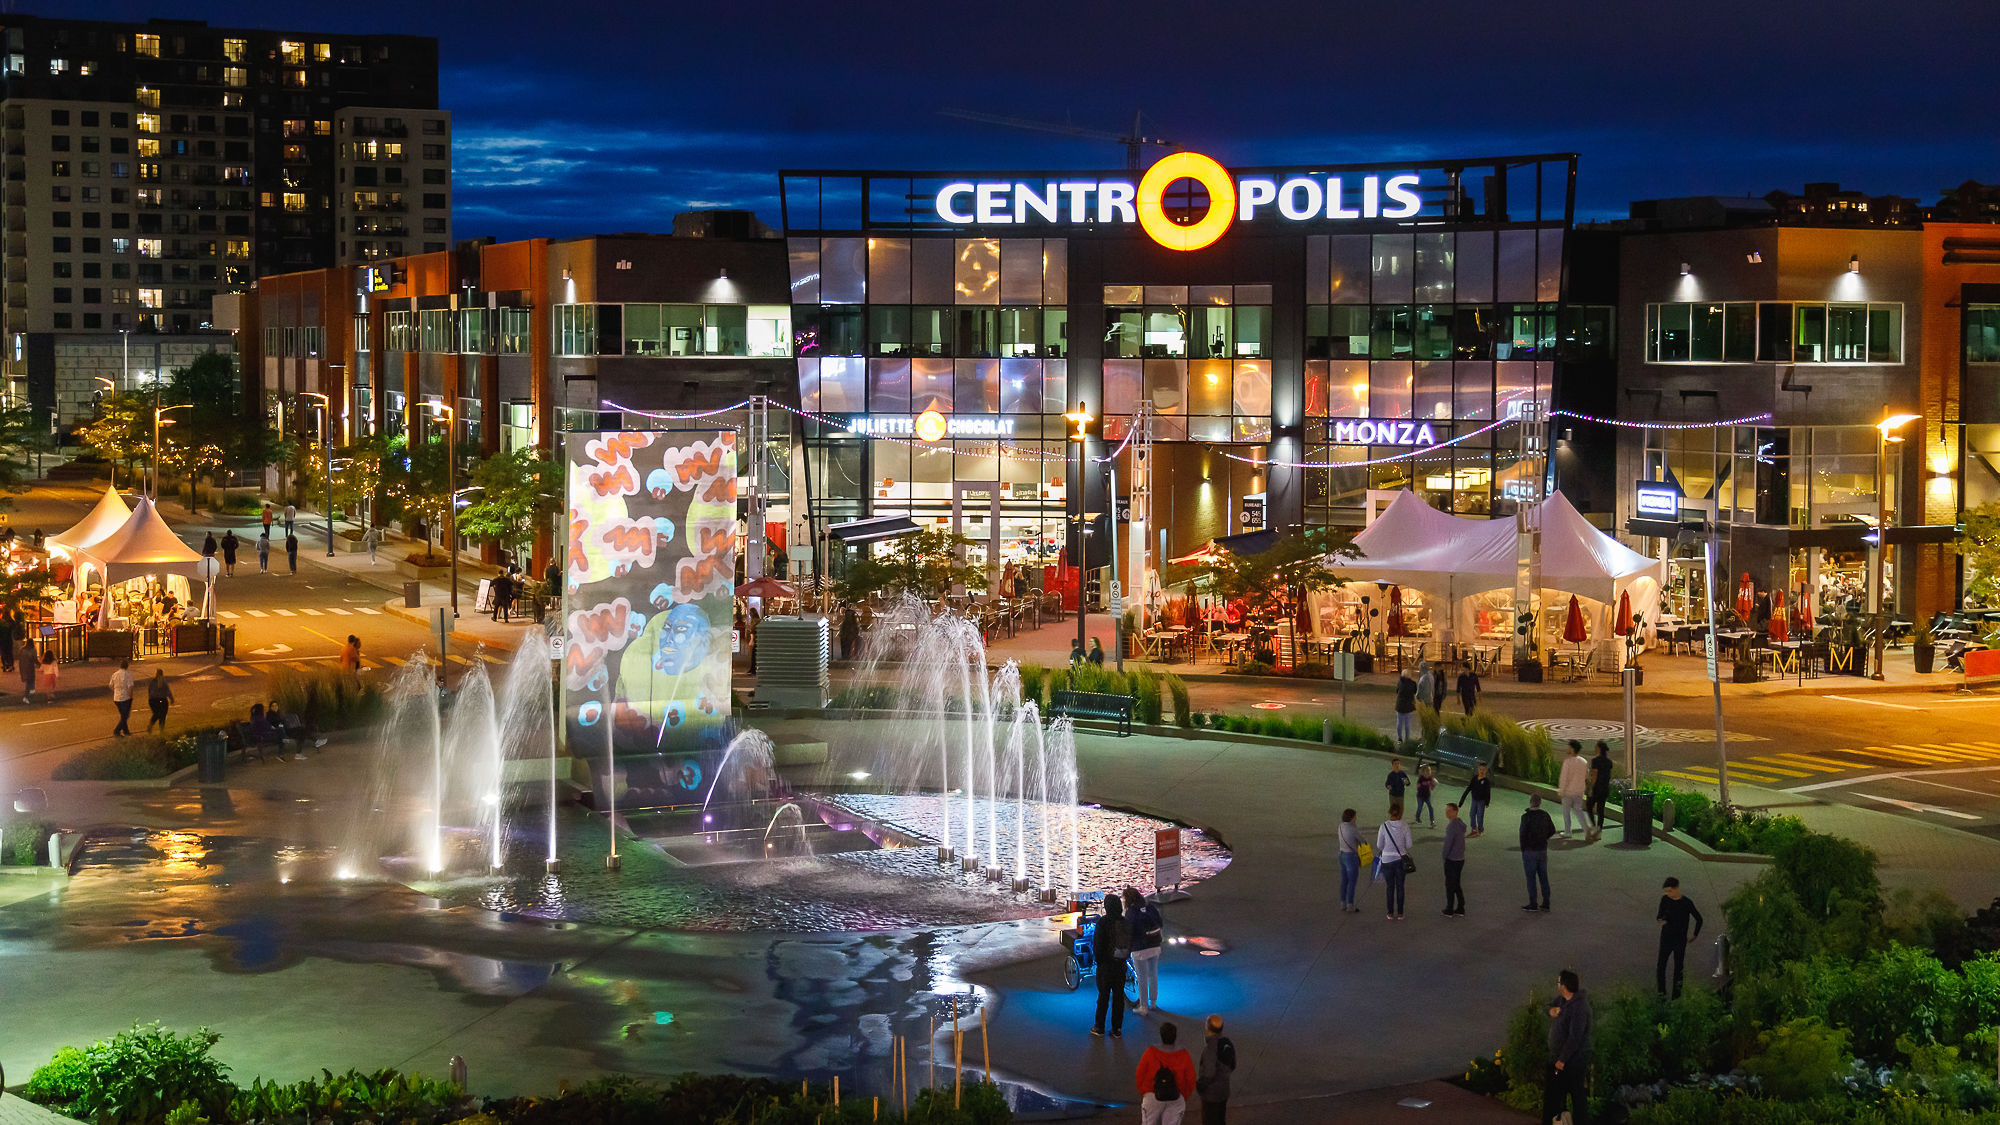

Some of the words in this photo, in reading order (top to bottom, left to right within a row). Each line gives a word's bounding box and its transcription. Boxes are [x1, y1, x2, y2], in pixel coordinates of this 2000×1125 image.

[936, 152, 1421, 251] CENTROPOLIS
[848, 418, 914, 434] JULIETTE
[948, 419, 1015, 434] CHOCOLAT
[1335, 421, 1435, 445] MONZA
